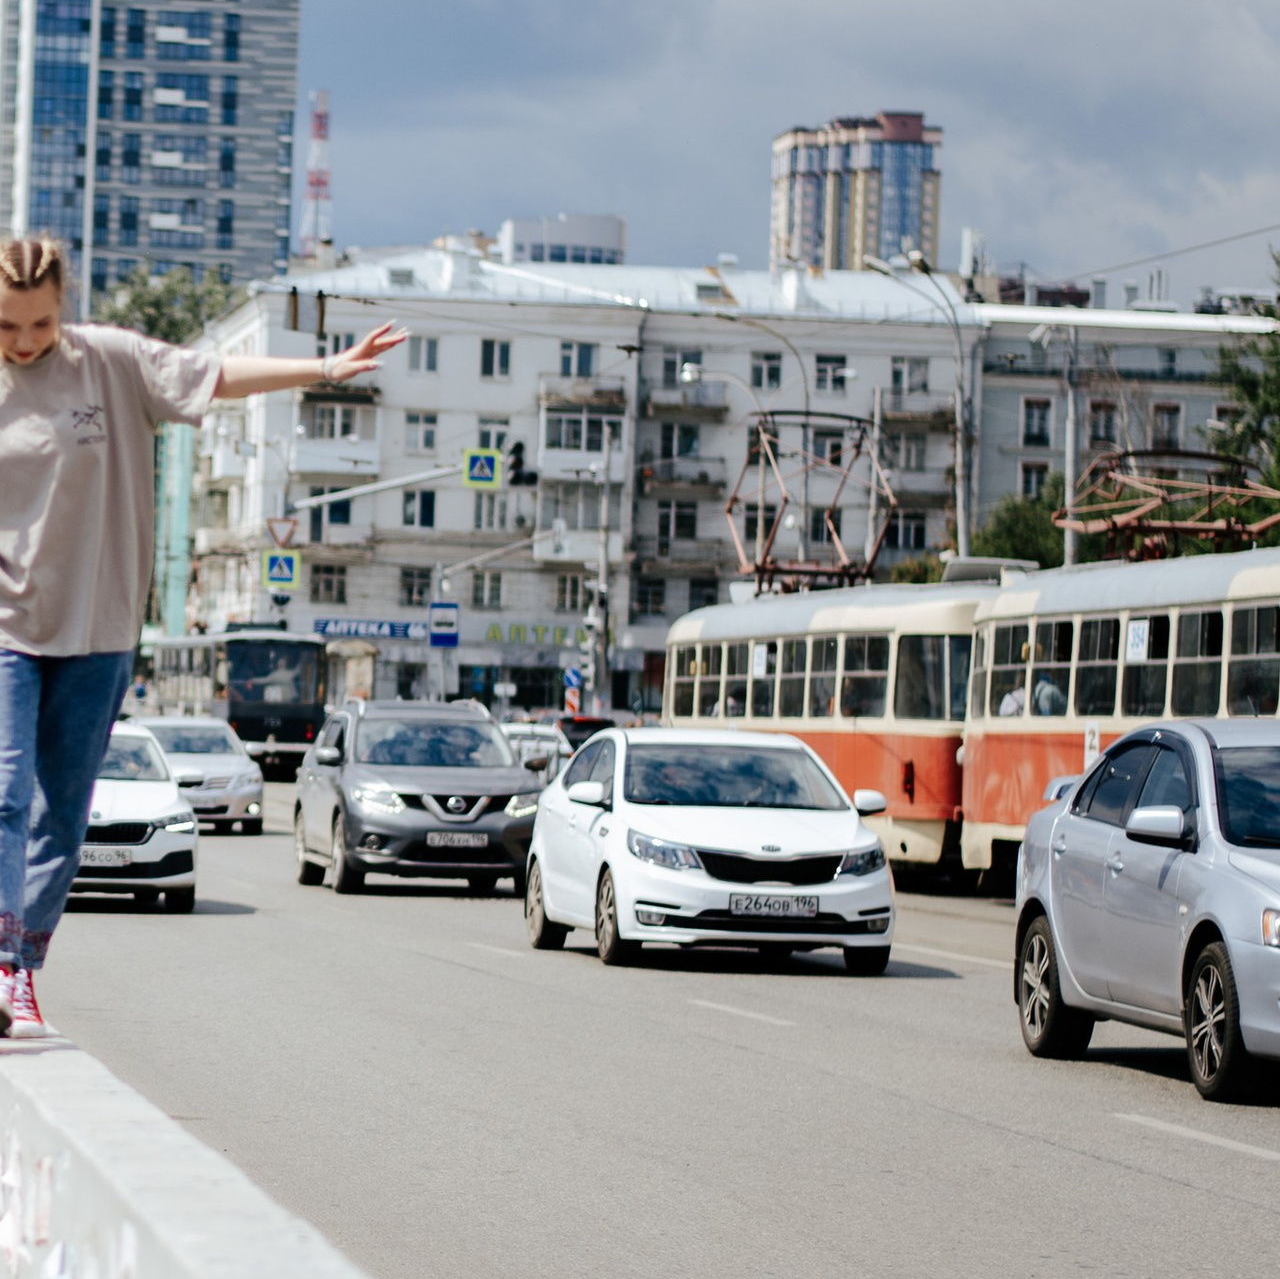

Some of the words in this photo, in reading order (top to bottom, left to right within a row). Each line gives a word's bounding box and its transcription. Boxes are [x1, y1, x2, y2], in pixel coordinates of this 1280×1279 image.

[325, 621, 391, 636] АПТЕКА
[1088, 728, 1096, 750] 2
[735, 896, 790, 912] Е264ОВ
[794, 896, 815, 909] 196
